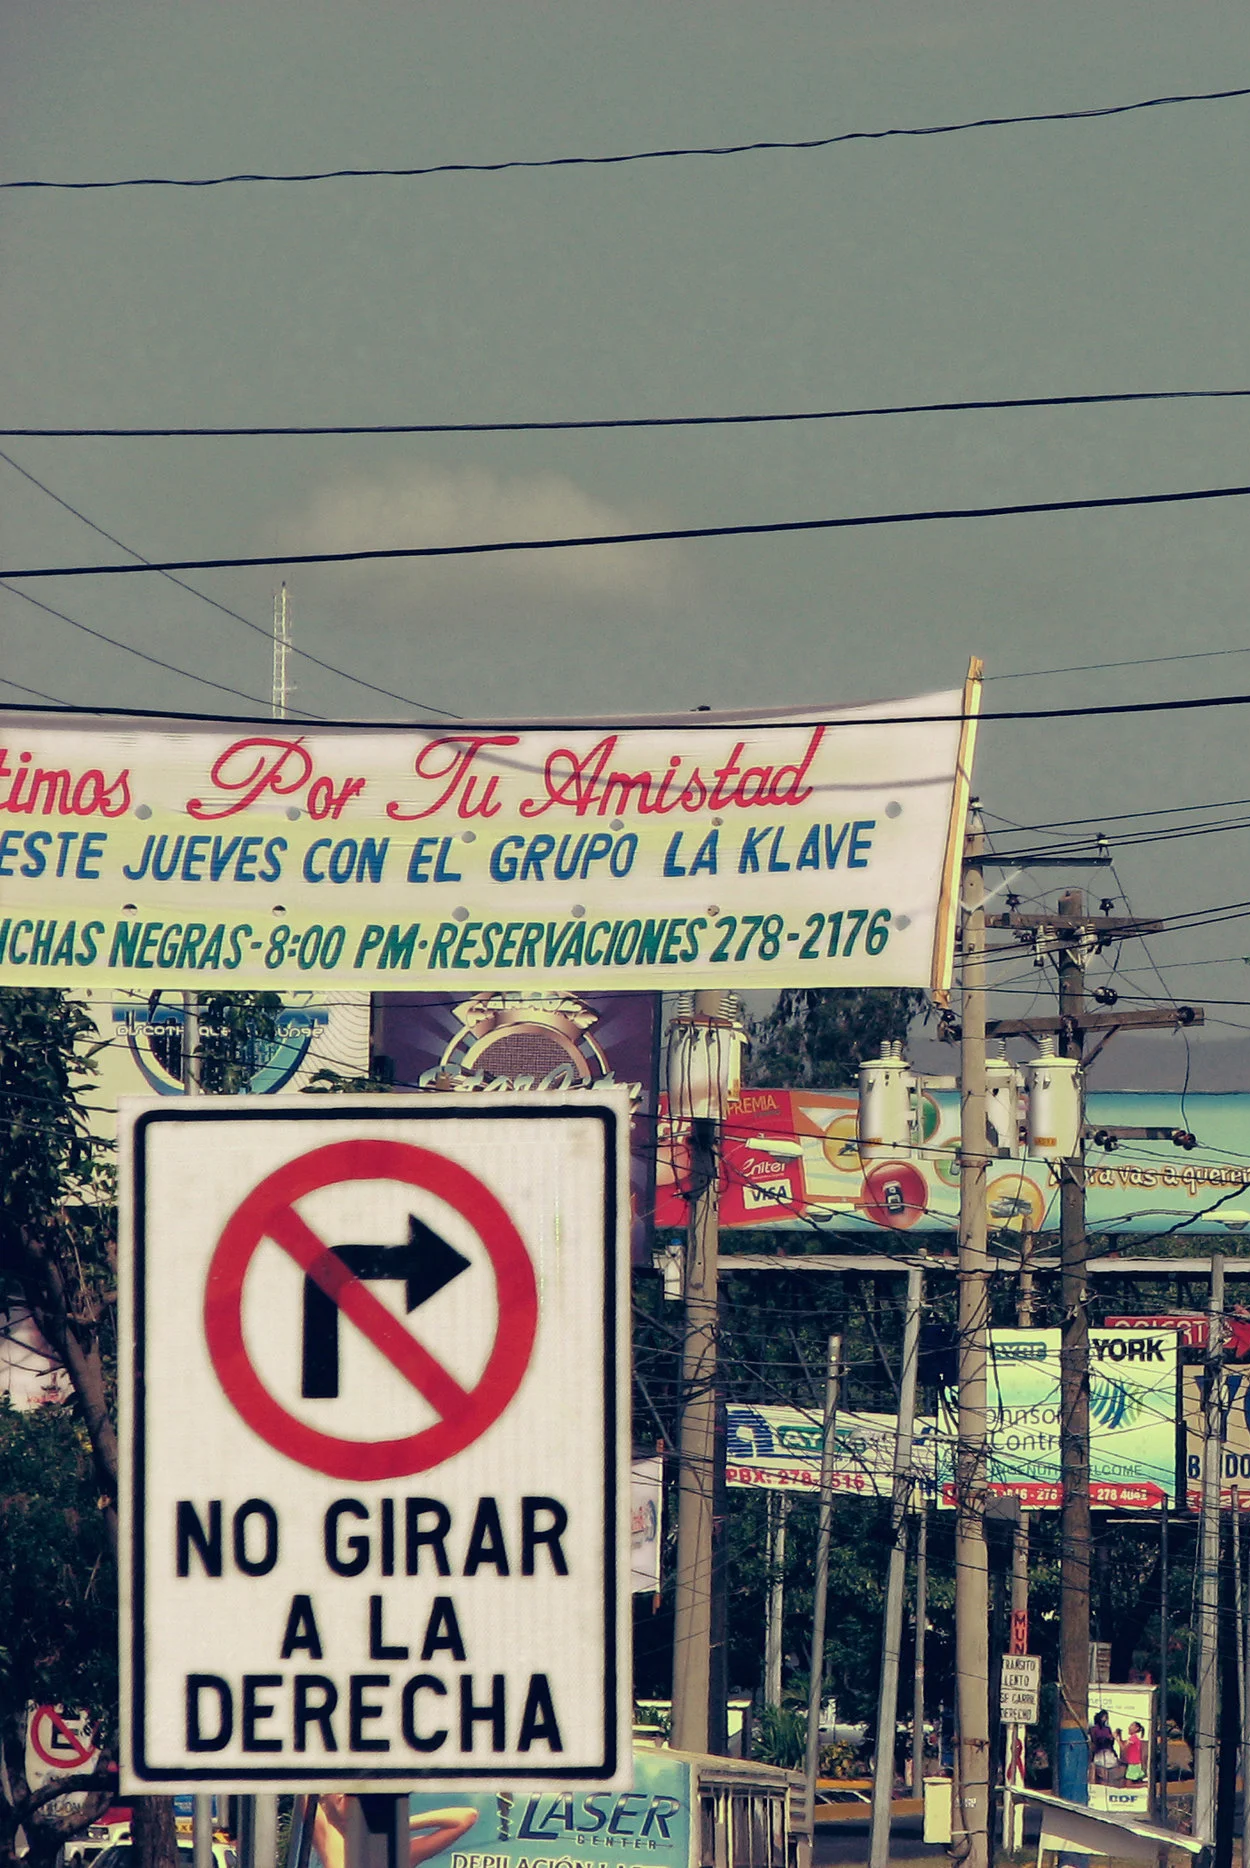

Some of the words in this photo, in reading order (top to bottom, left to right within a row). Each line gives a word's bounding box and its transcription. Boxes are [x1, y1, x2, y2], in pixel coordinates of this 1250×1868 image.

[187, 737, 366, 820] Por
[386, 736, 520, 820] Tu
[520, 725, 826, 818] Amistad
[0, 831, 107, 880] ESTE
[123, 835, 289, 883] JUEVES
[303, 837, 390, 884] CON
[407, 837, 463, 884] EL
[490, 833, 639, 882] GRUPO
[664, 830, 719, 878] LA
[738, 820, 876, 874] KLAVE
[710, 908, 892, 963] 278-2176
[727, 1095, 777, 1115] PREMIA
[752, 1186, 787, 1202] VISA
[1121, 1165, 1158, 1187] vas
[1165, 1167, 1179, 1186] a
[1183, 1166, 1250, 1195] querer
[1092, 1338, 1165, 1362] YORK
[985, 1405, 1061, 1425] ohnso
[991, 1431, 1061, 1450] Contr
[727, 1467, 773, 1485] PBX:
[777, 1470, 866, 1490] 278-516
[176, 1498, 279, 1578] NO
[325, 1497, 569, 1577] GIRAR
[280, 1594, 323, 1660] A
[370, 1594, 467, 1661] LA
[1003, 1659, 1036, 1671] RANSITO
[184, 1673, 564, 1753] DERECHA
[517, 1793, 681, 1841] LASER
